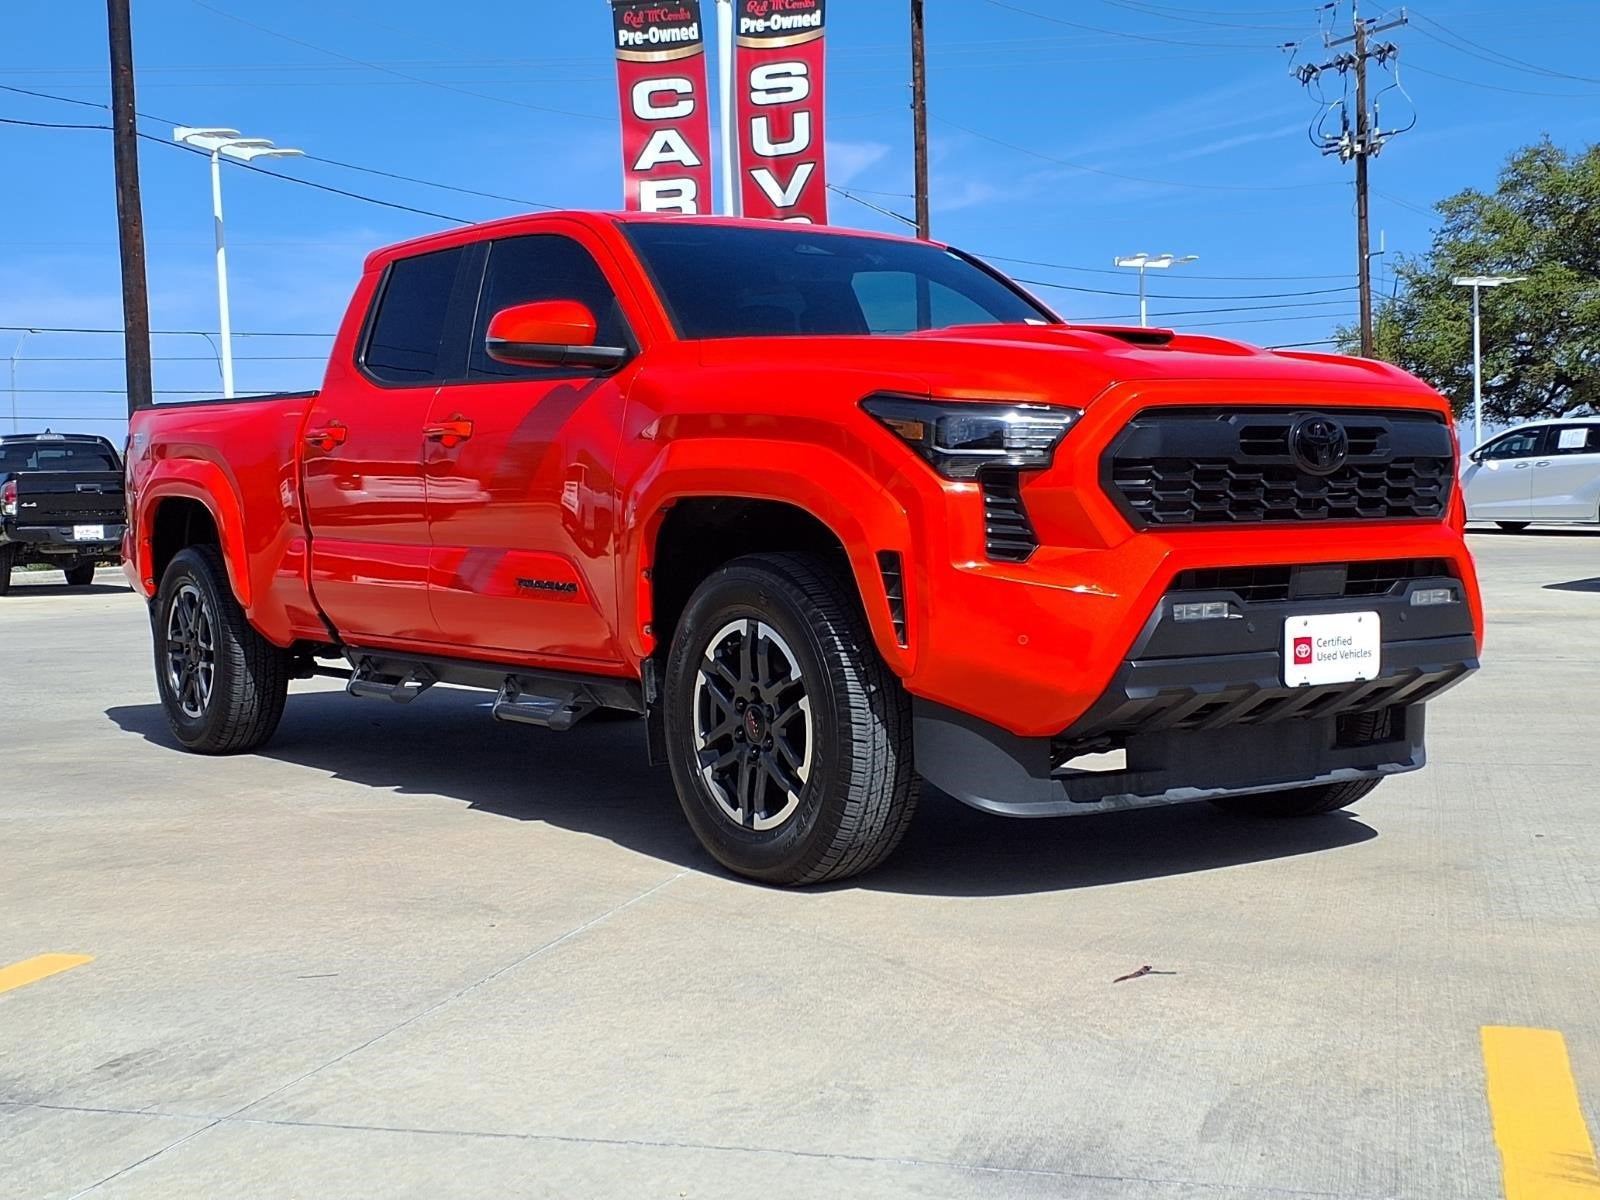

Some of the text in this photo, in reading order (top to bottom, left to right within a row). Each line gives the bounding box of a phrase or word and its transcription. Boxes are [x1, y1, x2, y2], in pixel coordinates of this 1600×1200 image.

[623, 10, 644, 29] Red
[740, 9, 821, 34] Pre-Owned
[618, 22, 699, 46] Pre-Owned
[749, 61, 816, 224] SUV
[1317, 636, 1352, 647] Certified
[1317, 648, 1372, 661] Used Vehicles
